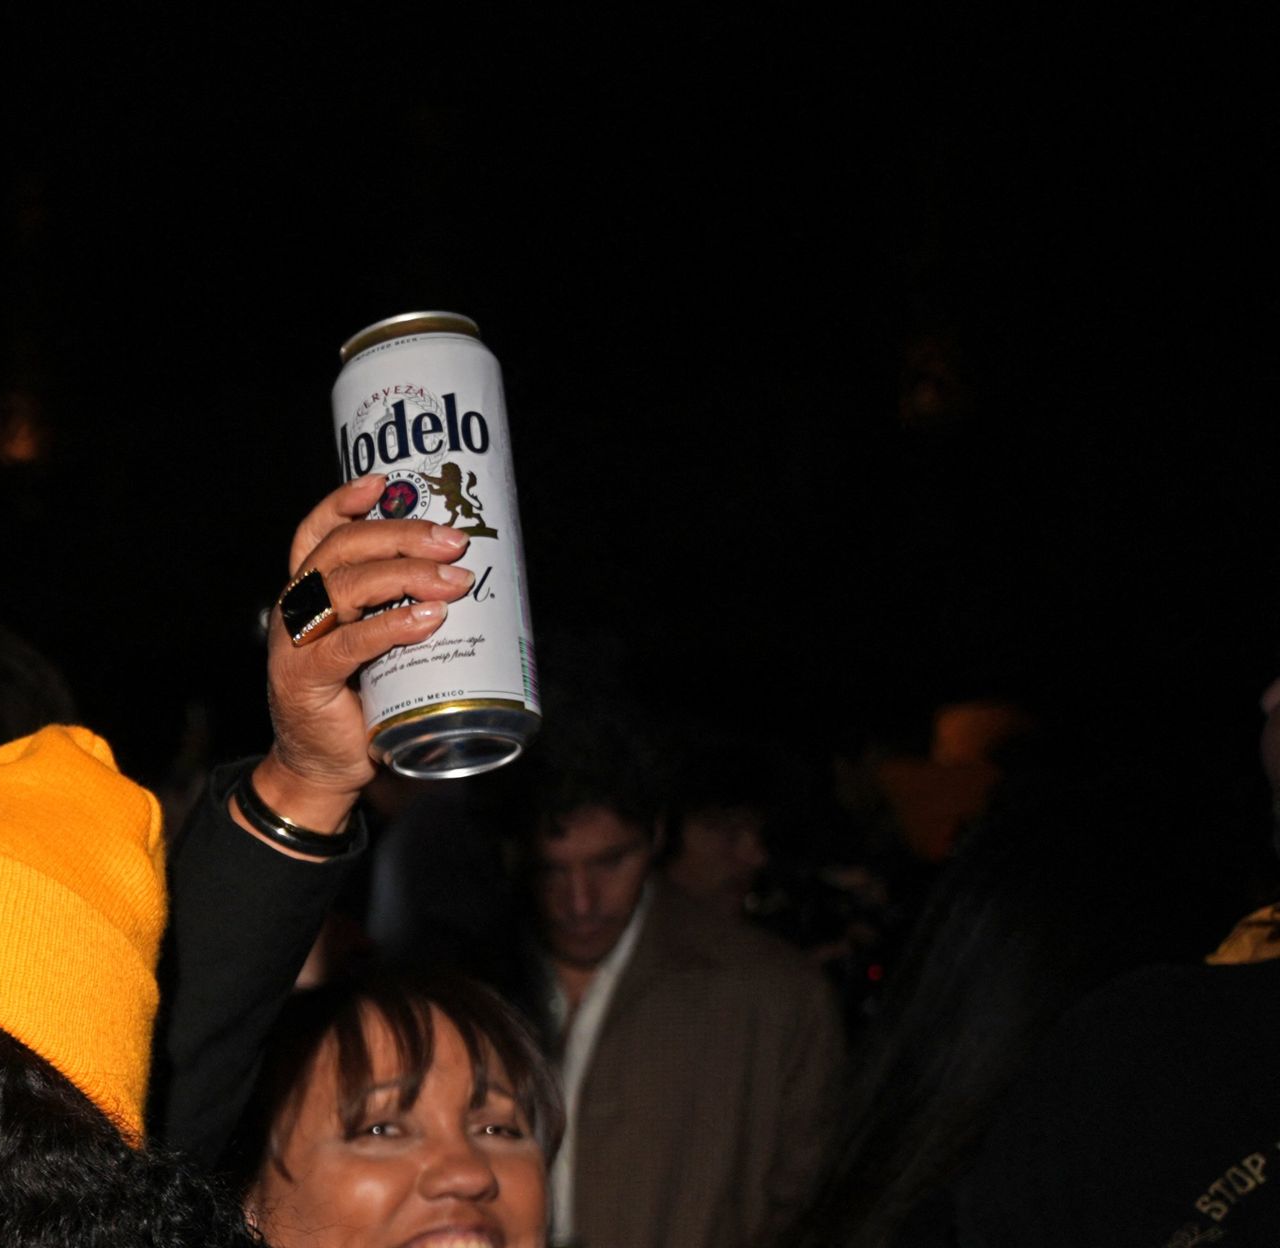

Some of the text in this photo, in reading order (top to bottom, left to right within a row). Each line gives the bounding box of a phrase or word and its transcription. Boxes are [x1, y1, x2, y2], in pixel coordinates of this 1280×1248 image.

[356, 385, 425, 417] CERVEZA
[381, 700, 412, 716] BREWED
[427, 689, 465, 701] MEXICO
[1194, 1151, 1268, 1223] STOP
